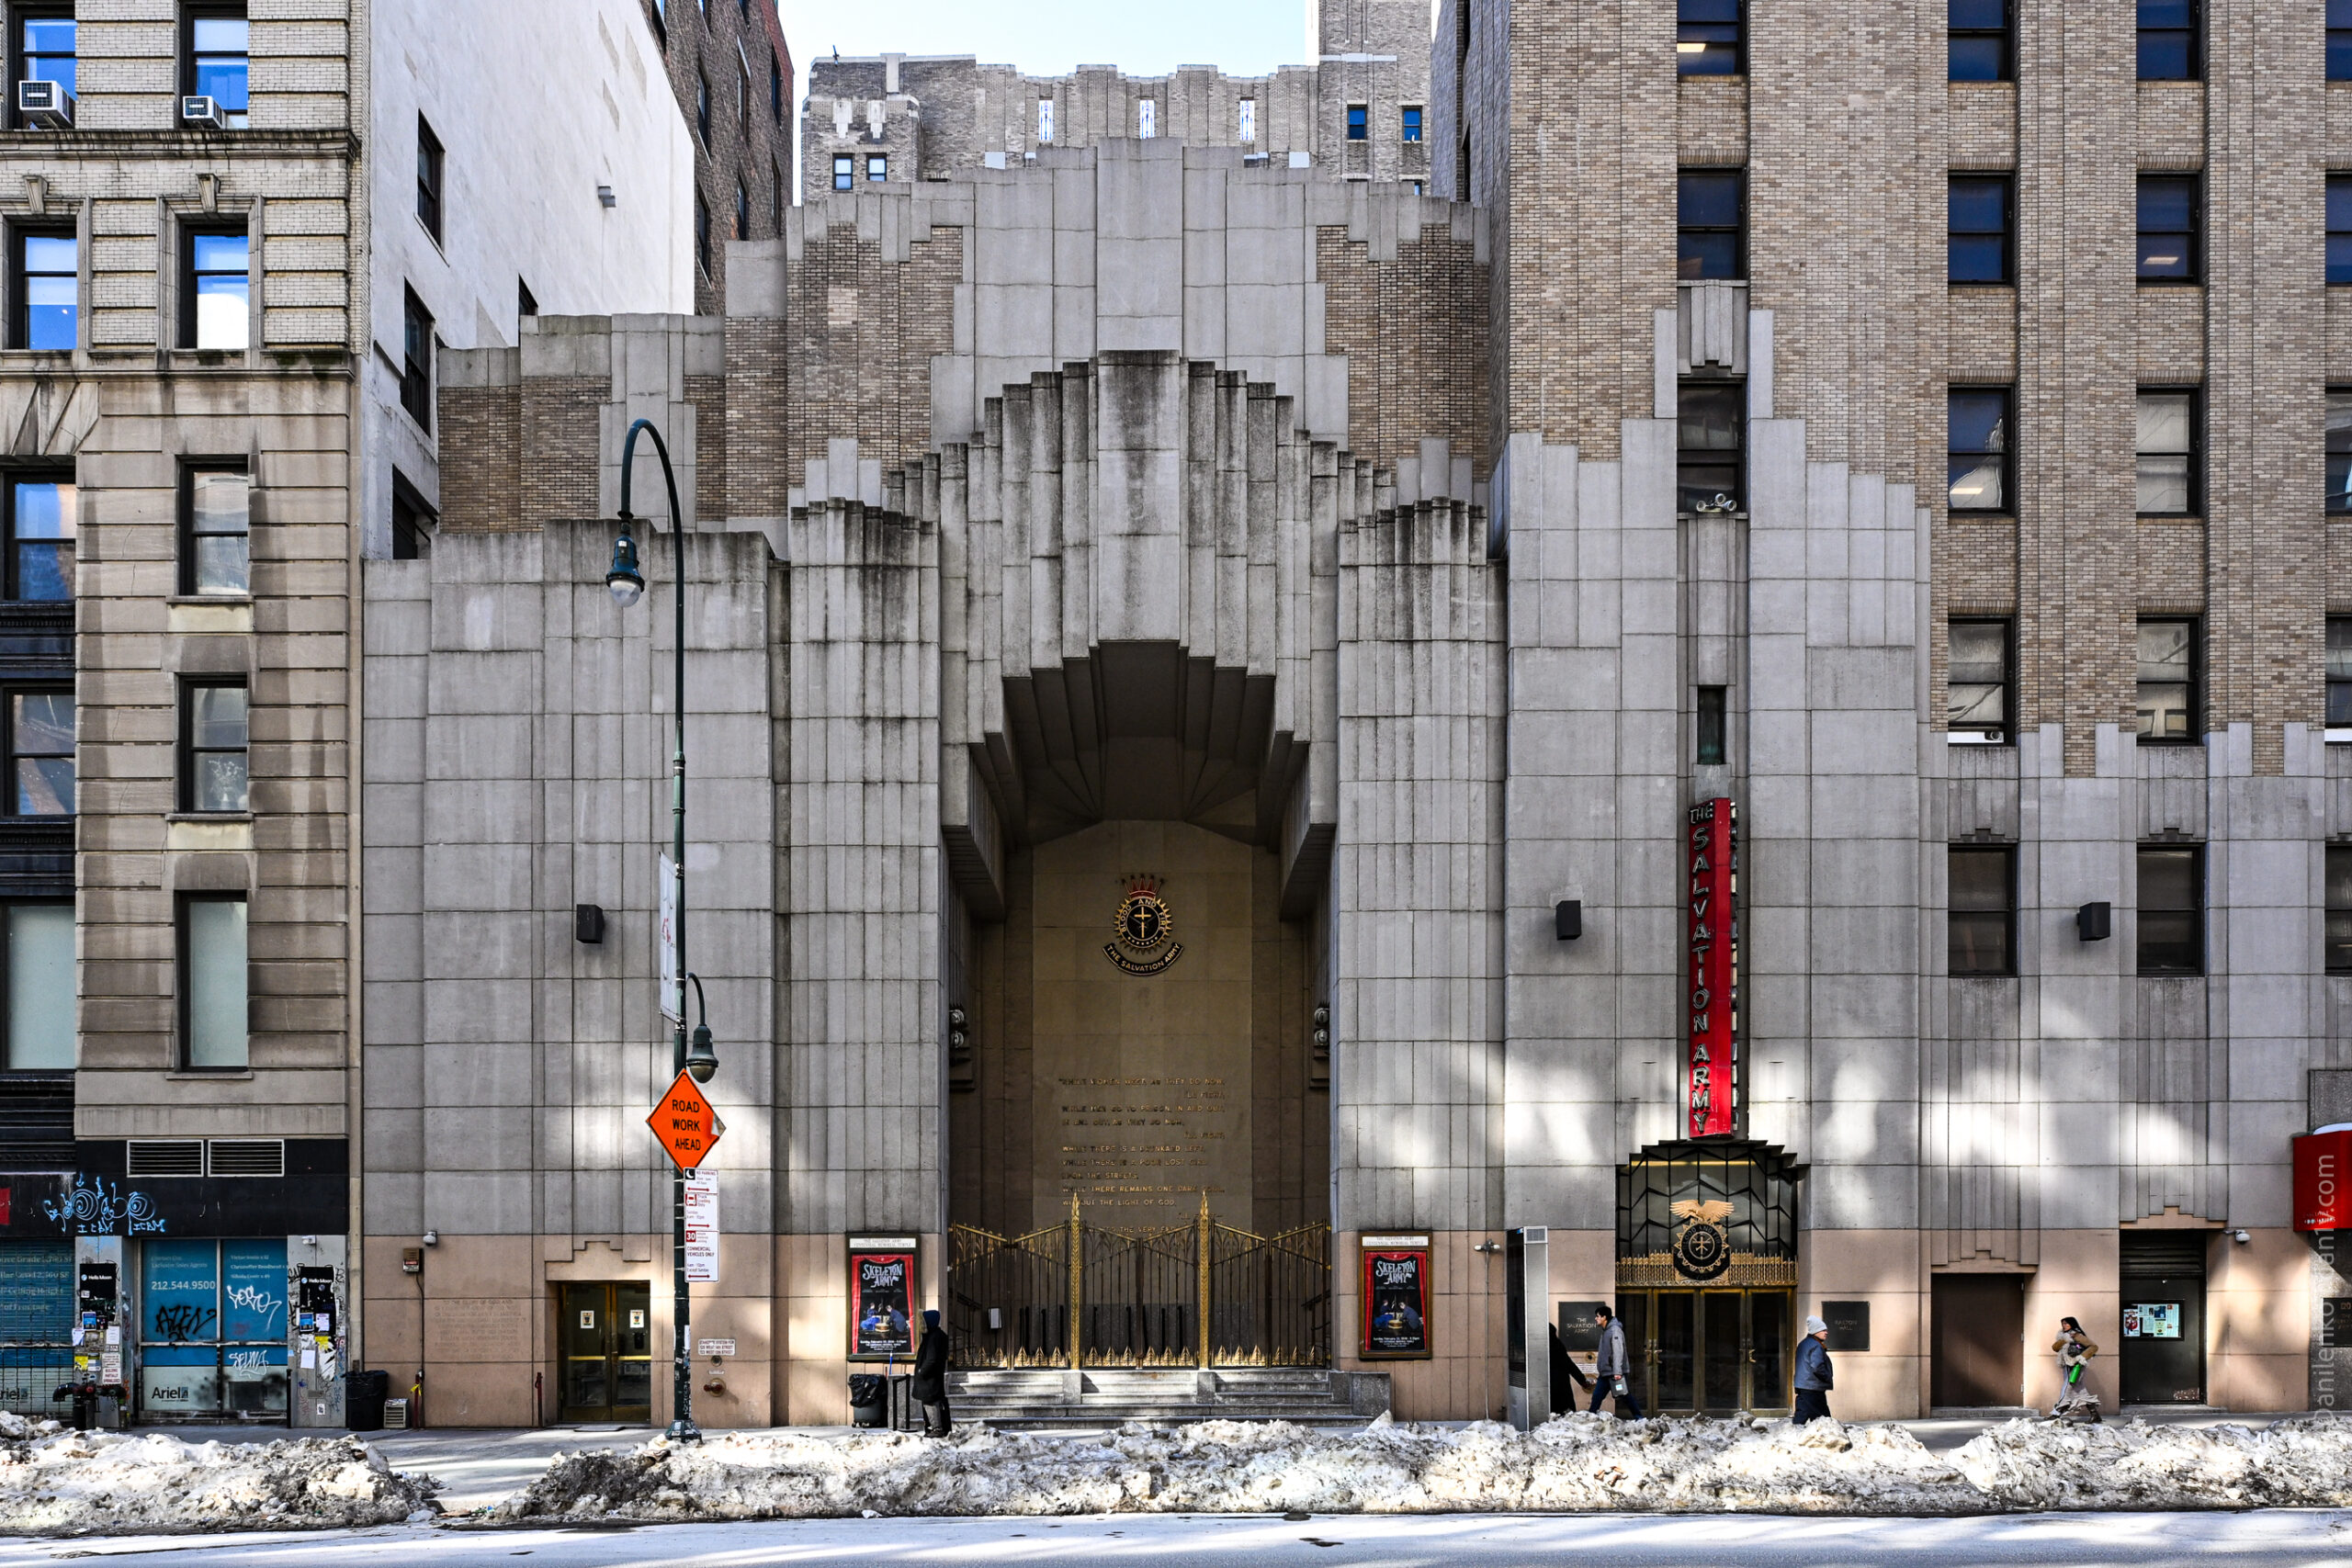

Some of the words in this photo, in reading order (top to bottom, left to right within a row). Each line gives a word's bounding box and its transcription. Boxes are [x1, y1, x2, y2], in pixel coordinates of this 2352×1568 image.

[1690, 802, 1713, 824] THE
[1120, 905, 1132, 932] BLOOD
[1138, 898, 1157, 908] AND
[1159, 912, 1168, 931] FIRE
[1691, 827, 1711, 1033] SALVATION
[1106, 944, 1120, 962] THE
[1121, 960, 1164, 972] SALVATION
[1164, 943, 1181, 963] ARMY
[1691, 1043, 1712, 1133] ARMY
[672, 1100, 700, 1112] ROAD
[672, 1118, 700, 1132] WORK
[674, 1137, 701, 1150] AHEAD
[863, 1263, 903, 1280] SKELETON
[1375, 1260, 1417, 1277] SKELETON
[151, 1280, 215, 1290] 212.544.9500
[871, 1275, 899, 1288] ARMY
[1384, 1271, 1412, 1284] ARMY
[152, 1387, 180, 1399] Ariel
